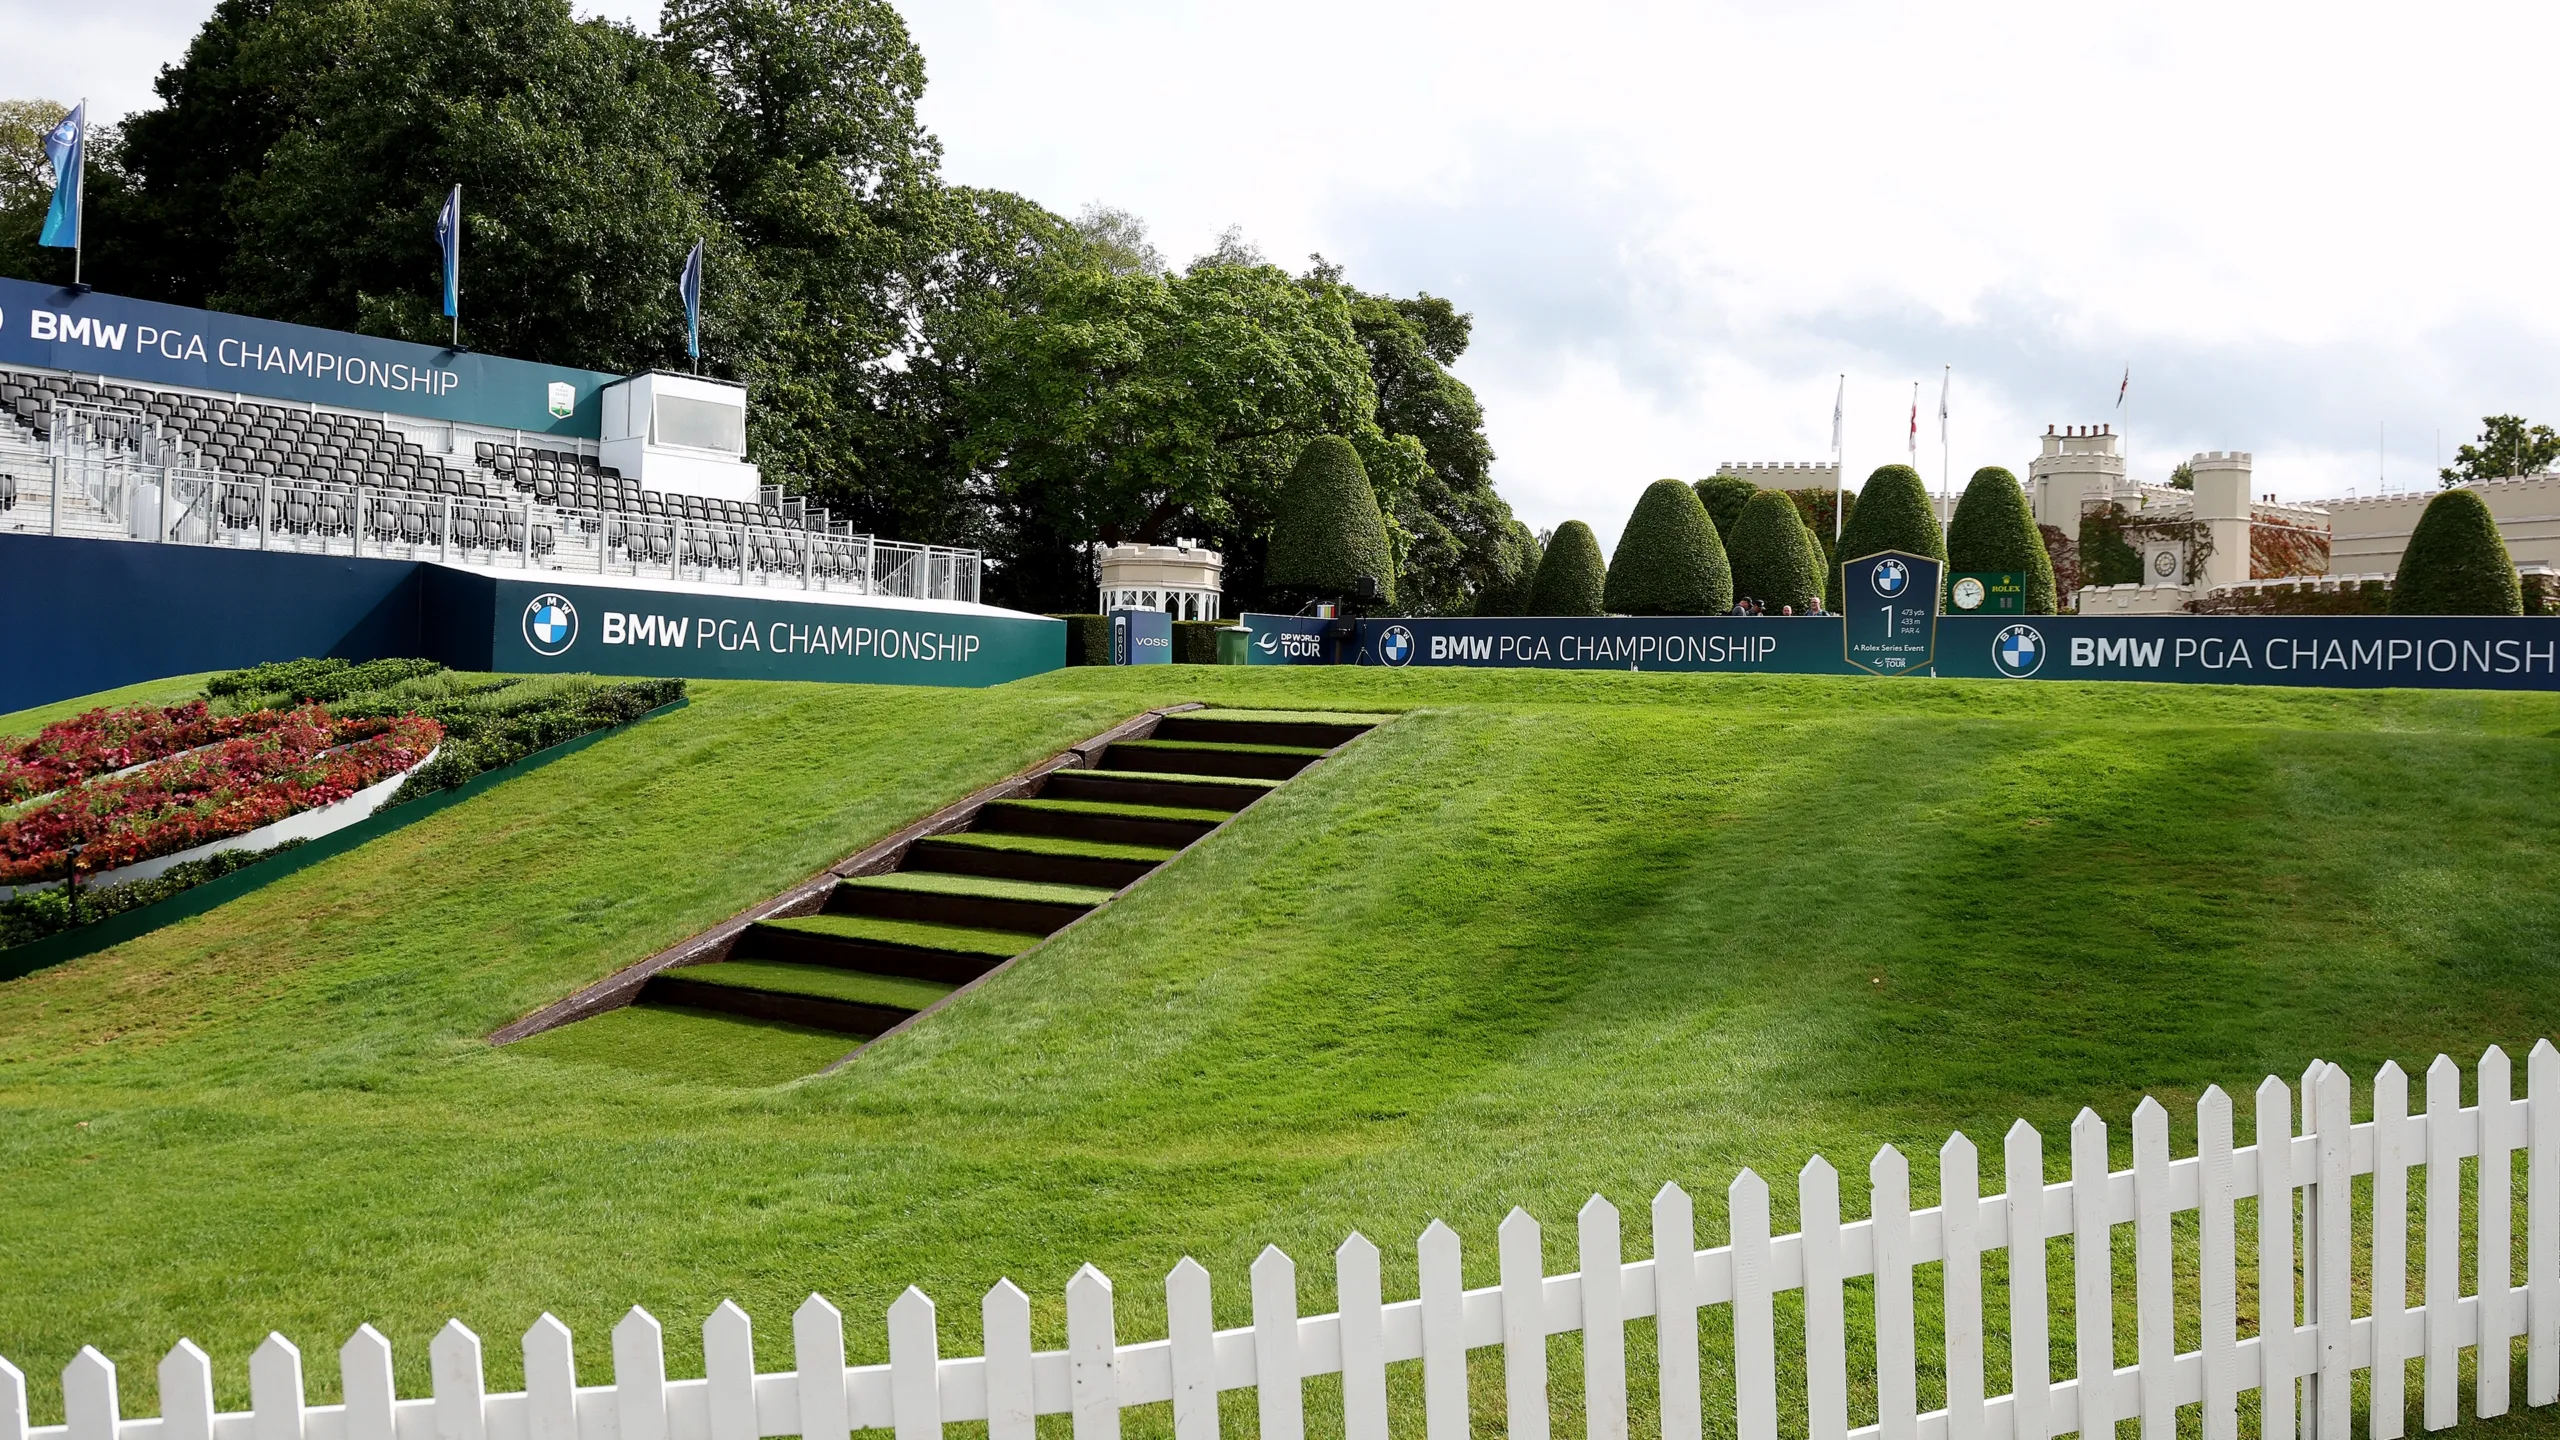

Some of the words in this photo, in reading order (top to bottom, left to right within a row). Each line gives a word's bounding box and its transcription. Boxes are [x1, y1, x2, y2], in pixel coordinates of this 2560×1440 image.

[30, 309, 128, 351] BMW
[136, 326, 208, 363] PGA
[218, 337, 459, 397] CHAMPIONSHIP
[1876, 562, 1905, 572] BMW
[1991, 585, 2021, 593] ROLEX
[531, 596, 572, 615] BMW
[1914, 609, 1925, 617] yds
[1881, 604, 1893, 638] 1
[603, 611, 688, 648] BMW
[697, 618, 761, 652] PGA
[769, 622, 980, 662] CHAMPIONSHIP
[1281, 633, 1292, 641] DP
[1292, 634, 1321, 642] WORLD
[1384, 628, 1410, 640] BMW
[2000, 627, 2039, 642] BMW
[1135, 637, 1169, 647] VOSS
[1431, 635, 1493, 660] BMW
[1499, 635, 1551, 661] PGA
[1559, 635, 1777, 662] CHAMPIONSHIP
[1861, 644, 1880, 652] Rolex
[1881, 644, 1903, 652] Series
[1904, 644, 1925, 652] Event
[1281, 641, 1321, 658] TOUR
[2070, 637, 2165, 667] BMW
[2175, 637, 2253, 669] PGA
[2265, 638, 2554, 673] CHAMPIONSH
[1885, 660, 1906, 668] TOUR
